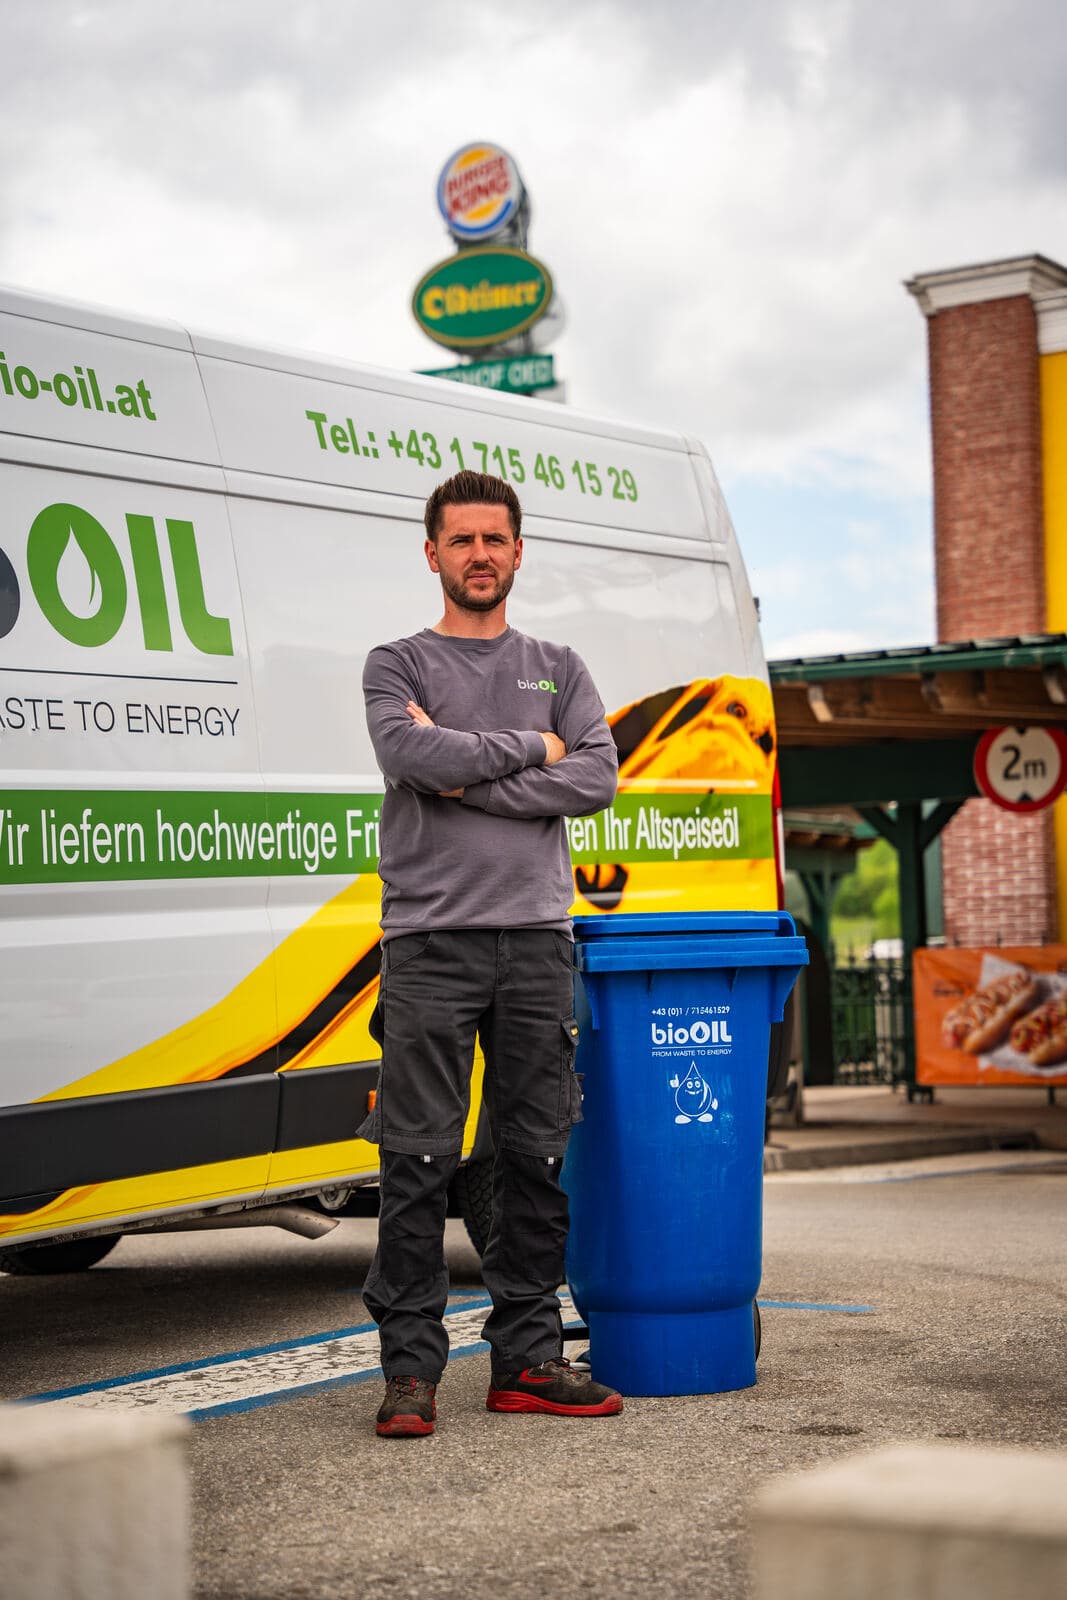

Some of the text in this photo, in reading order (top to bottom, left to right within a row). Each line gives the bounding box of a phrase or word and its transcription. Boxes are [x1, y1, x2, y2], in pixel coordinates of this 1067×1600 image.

[305, 410, 638, 502] Tel.: +43 1 715 46 15 29
[0, 697, 240, 737] STE TO ENERGY
[0, 808, 30, 866] ir
[41, 808, 146, 865] liefern
[156, 808, 337, 873] hochwertige
[603, 806, 632, 851] Ihr
[635, 806, 740, 860] Altspeiseöl
[651, 1007, 666, 1016] +43
[668, 1007, 683, 1017] (0)1
[691, 1006, 731, 1015] 715461529
[651, 1020, 732, 1045] bioOIL
[707, 1048, 732, 1056] ENERGY
